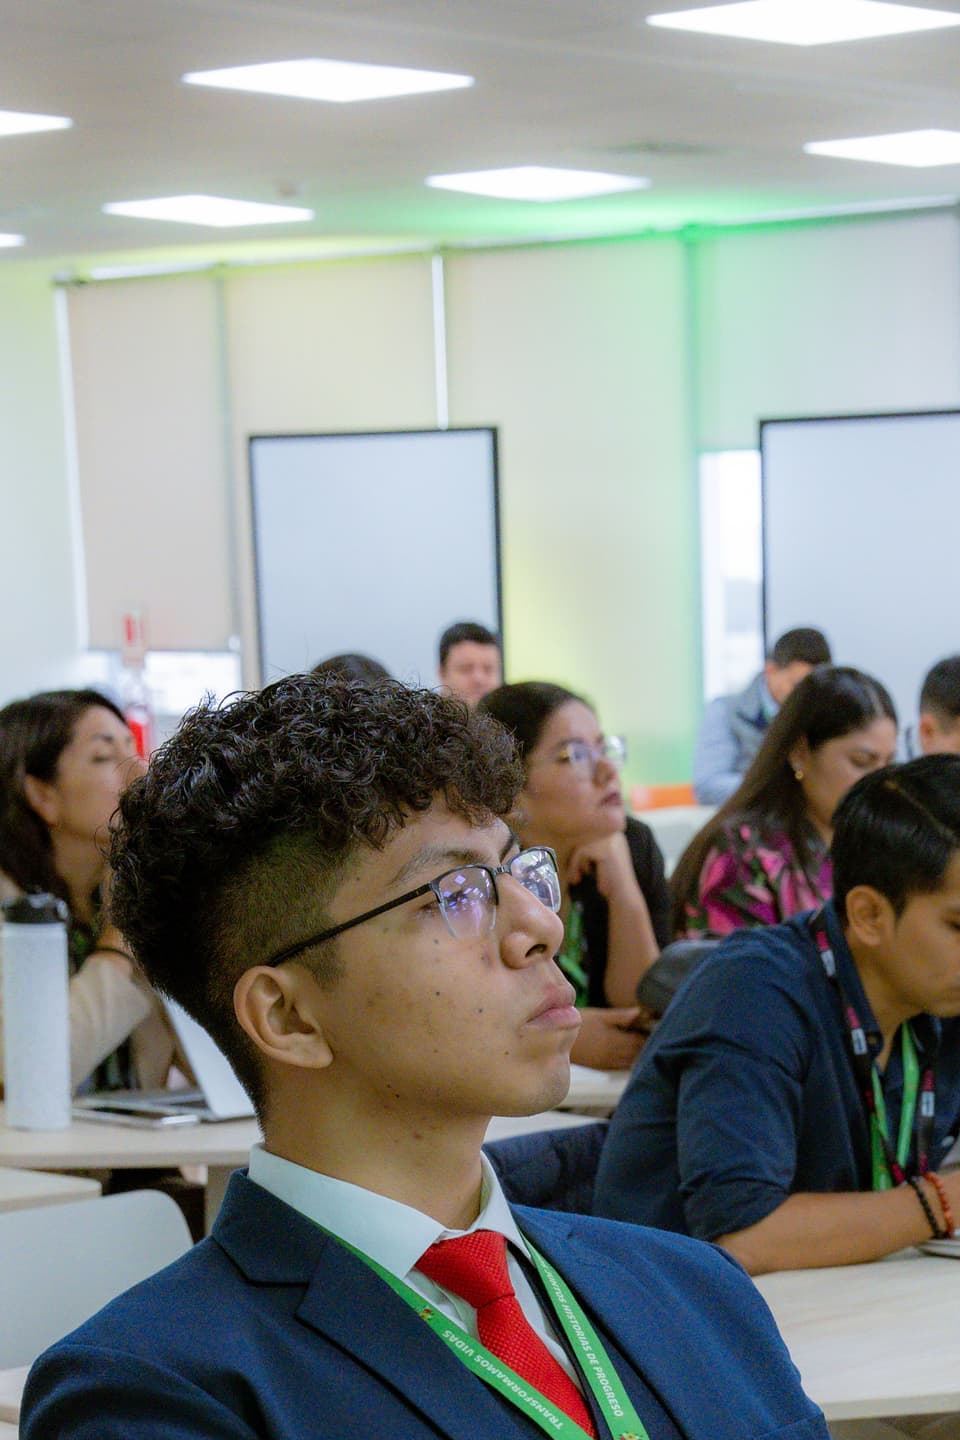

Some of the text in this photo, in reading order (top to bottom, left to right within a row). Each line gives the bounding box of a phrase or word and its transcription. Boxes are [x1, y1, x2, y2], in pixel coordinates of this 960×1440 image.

[442, 1330, 564, 1430] TRANSFORMAMOS VIDAS
[562, 1303, 593, 1352] HISTORIAS
[586, 1353, 600, 1367] DE
[593, 1366, 624, 1417] PROGRESO
